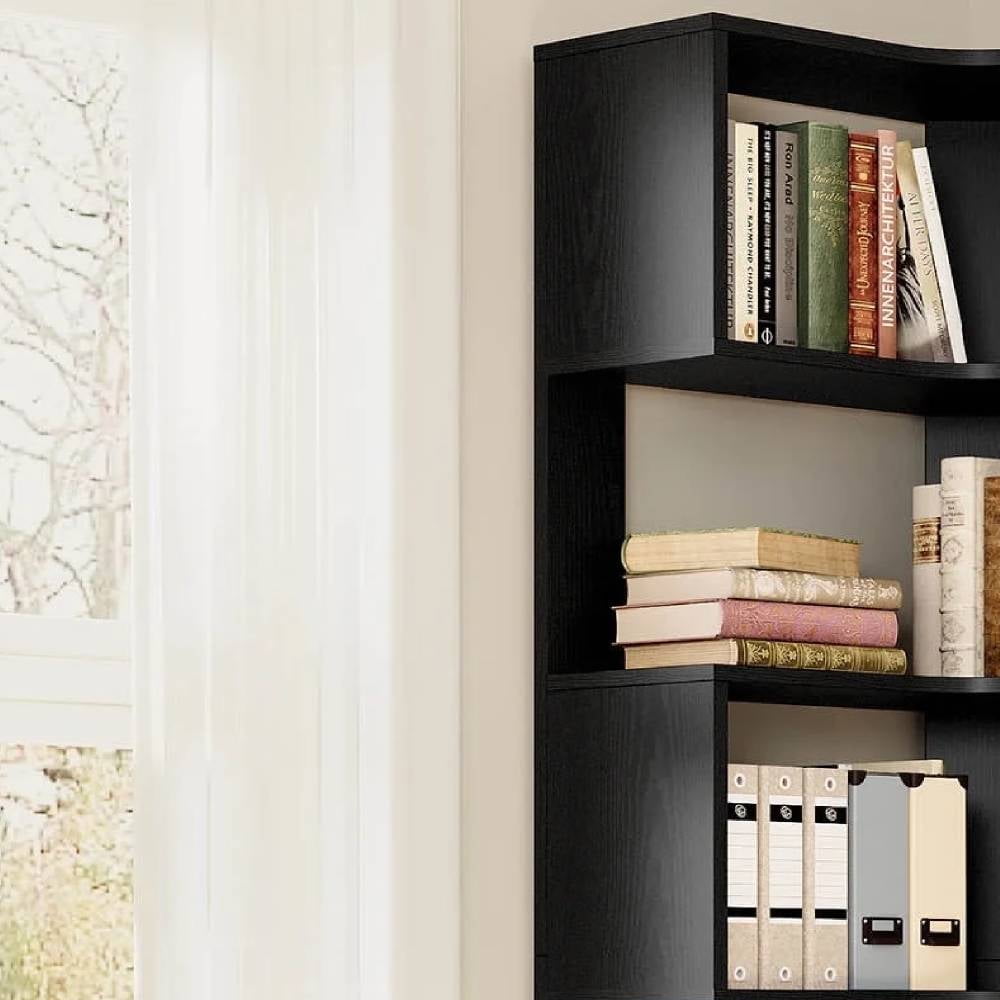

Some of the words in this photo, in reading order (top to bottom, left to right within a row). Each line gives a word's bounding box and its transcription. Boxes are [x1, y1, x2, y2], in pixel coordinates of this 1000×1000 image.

[784, 142, 794, 169] Ron
[784, 173, 794, 205] Arad
[881, 144, 895, 327] INNENARCHITEKTUR
